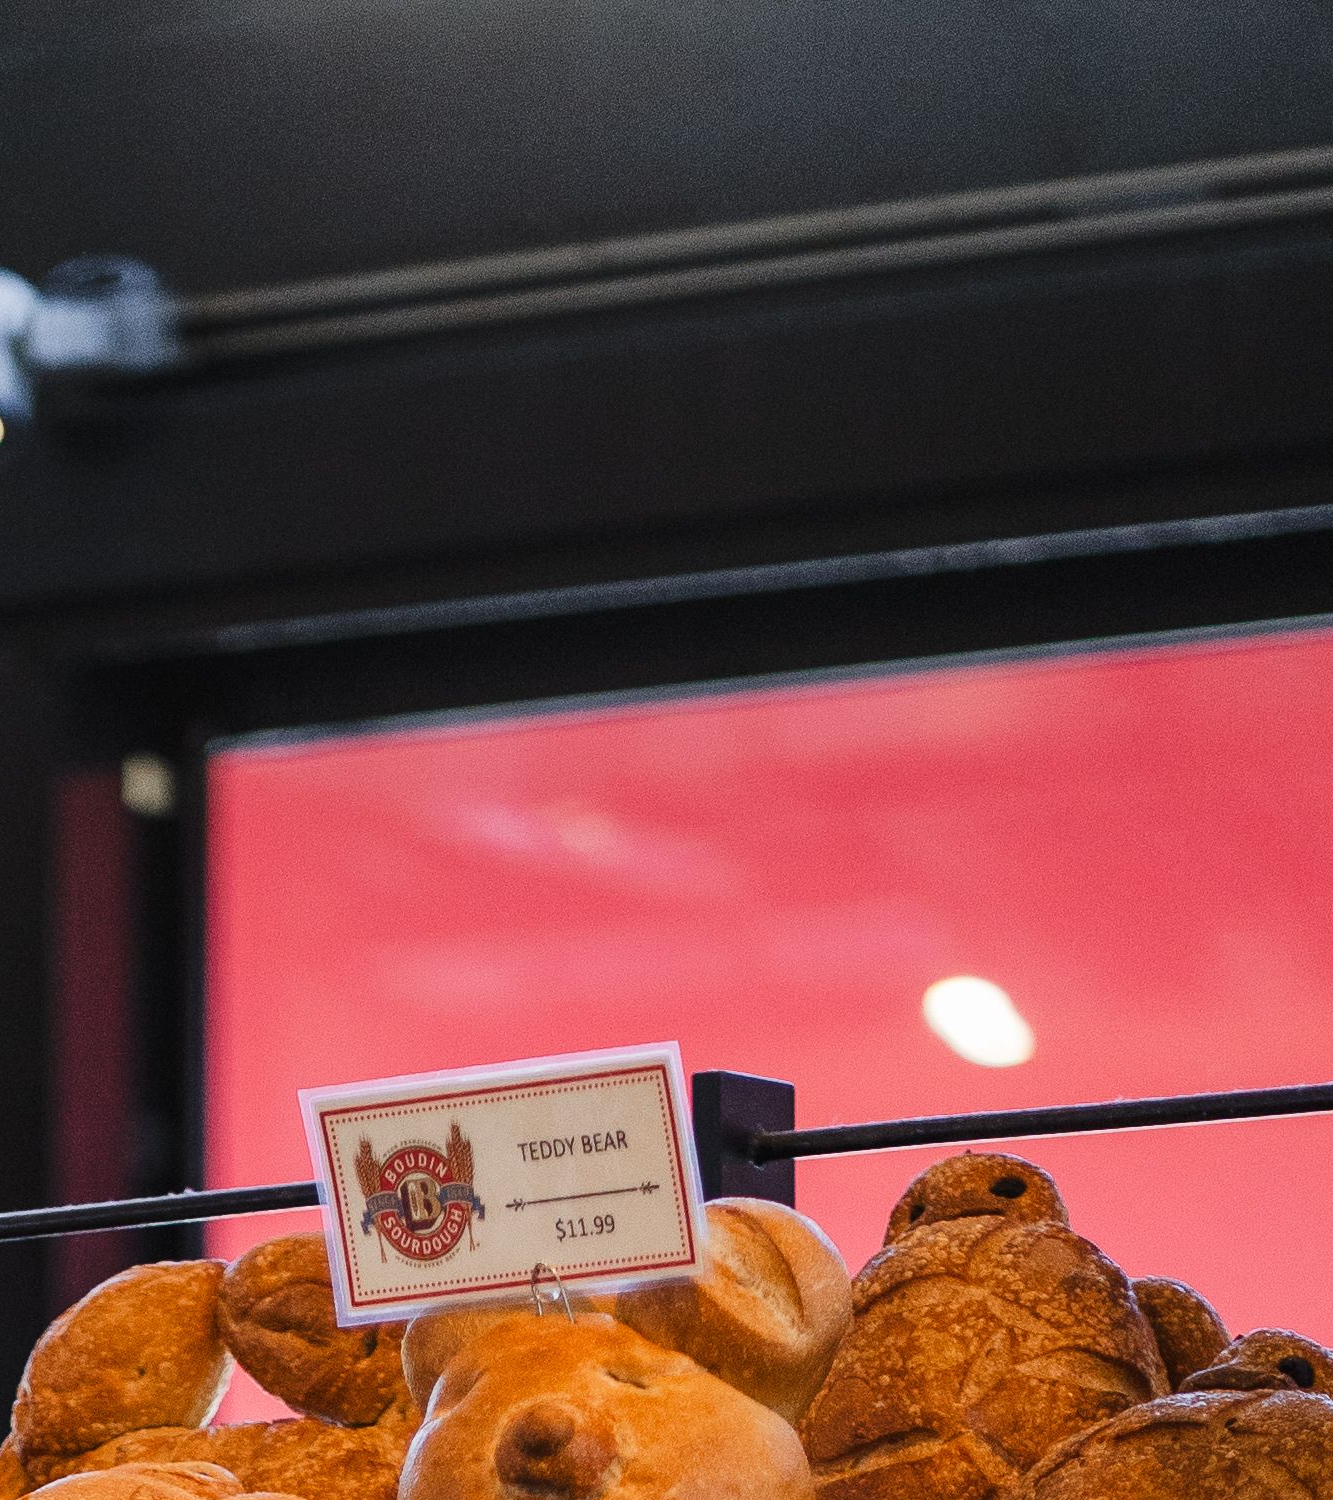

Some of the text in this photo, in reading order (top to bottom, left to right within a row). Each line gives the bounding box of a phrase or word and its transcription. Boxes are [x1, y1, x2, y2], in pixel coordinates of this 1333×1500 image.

[517, 1129, 629, 1162] TEDDY BEAR
[384, 1152, 449, 1184] BOUDIN
[400, 1178, 442, 1231] B
[383, 1208, 463, 1255] SOURDOUGH
[555, 1213, 616, 1243] $11.99
